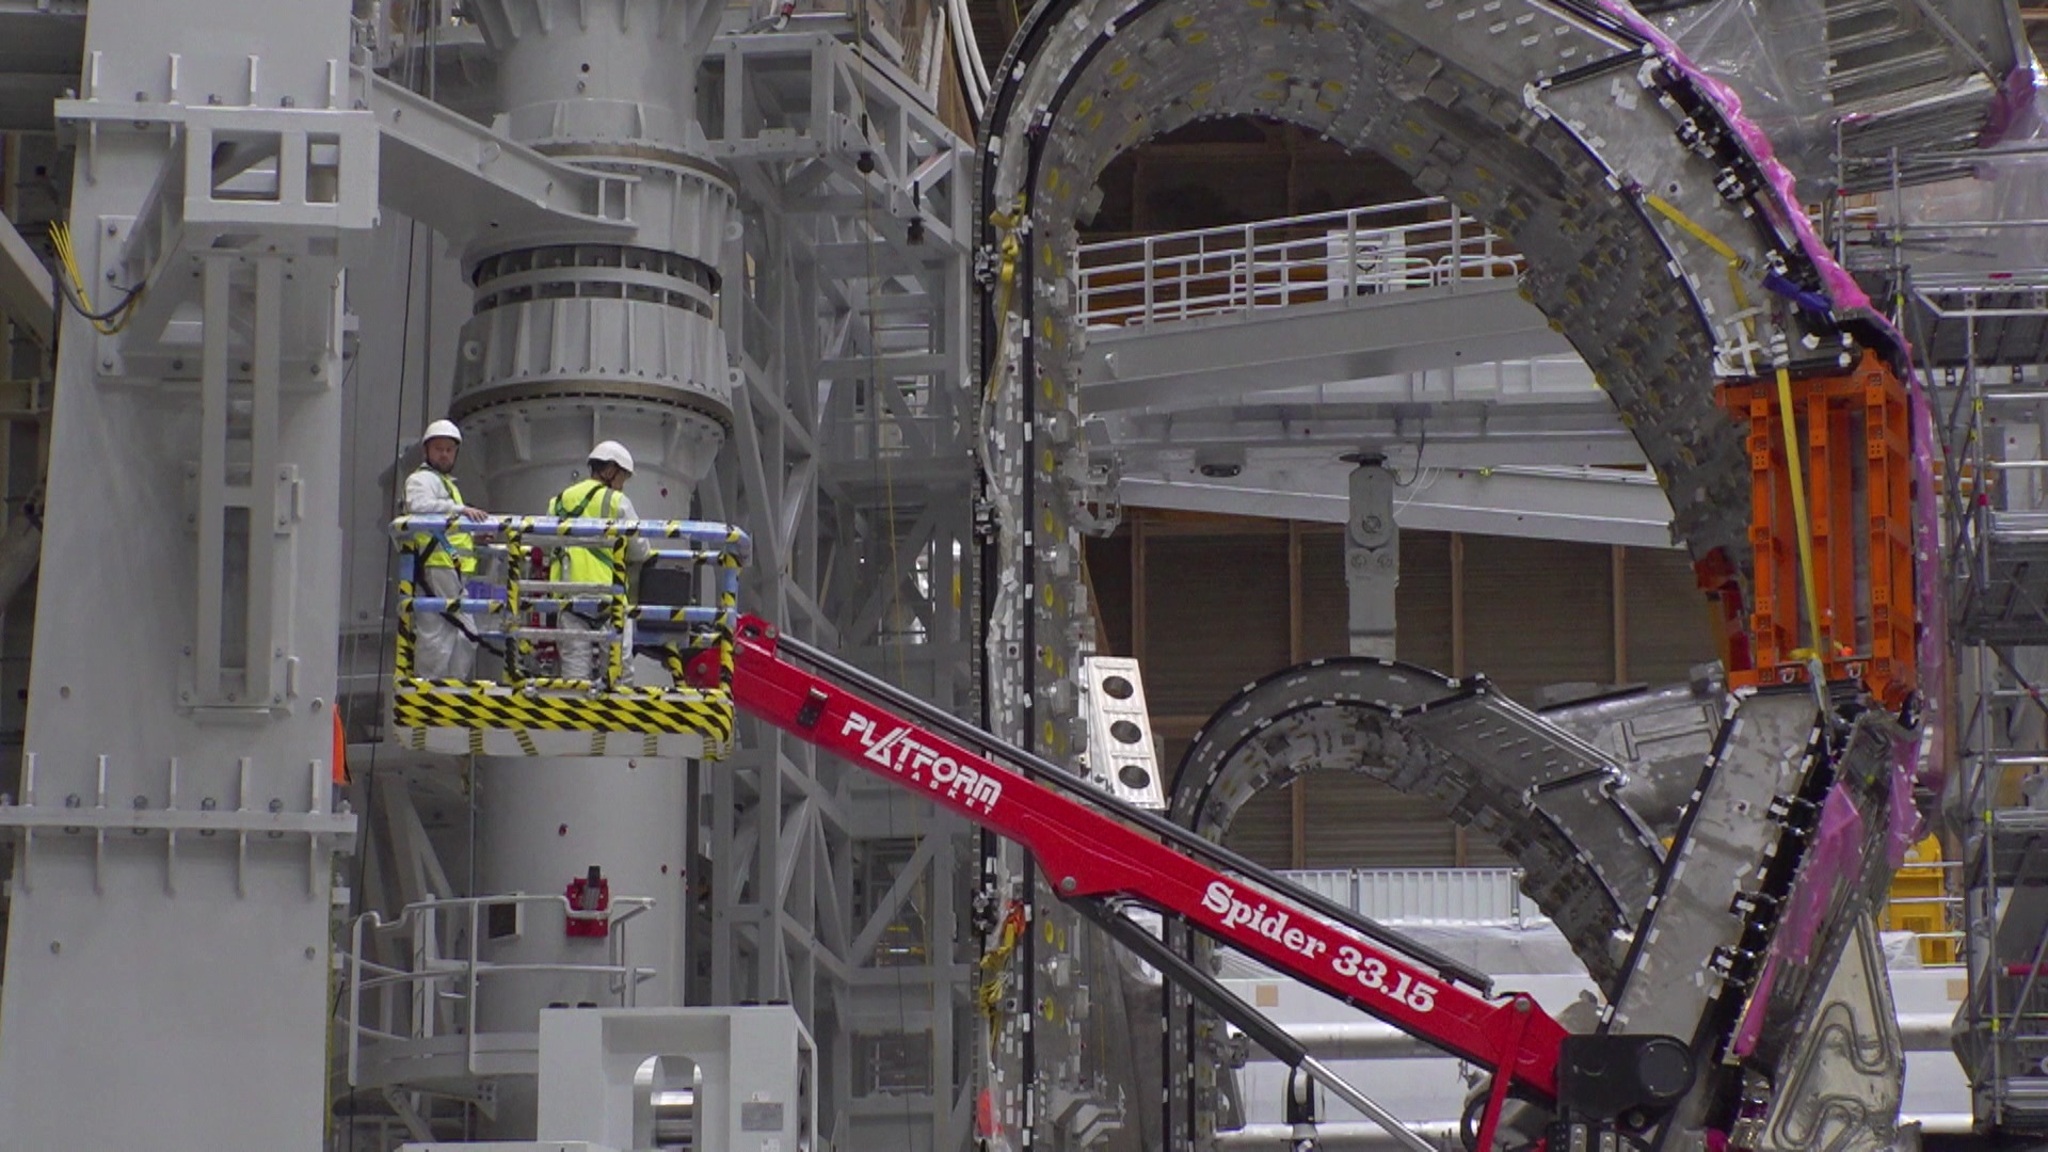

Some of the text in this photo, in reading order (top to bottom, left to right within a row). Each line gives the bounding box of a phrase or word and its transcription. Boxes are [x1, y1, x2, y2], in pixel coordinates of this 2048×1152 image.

[841, 711, 1003, 808] PLATFORM
[1201, 880, 1438, 1012] Spider 33.15
